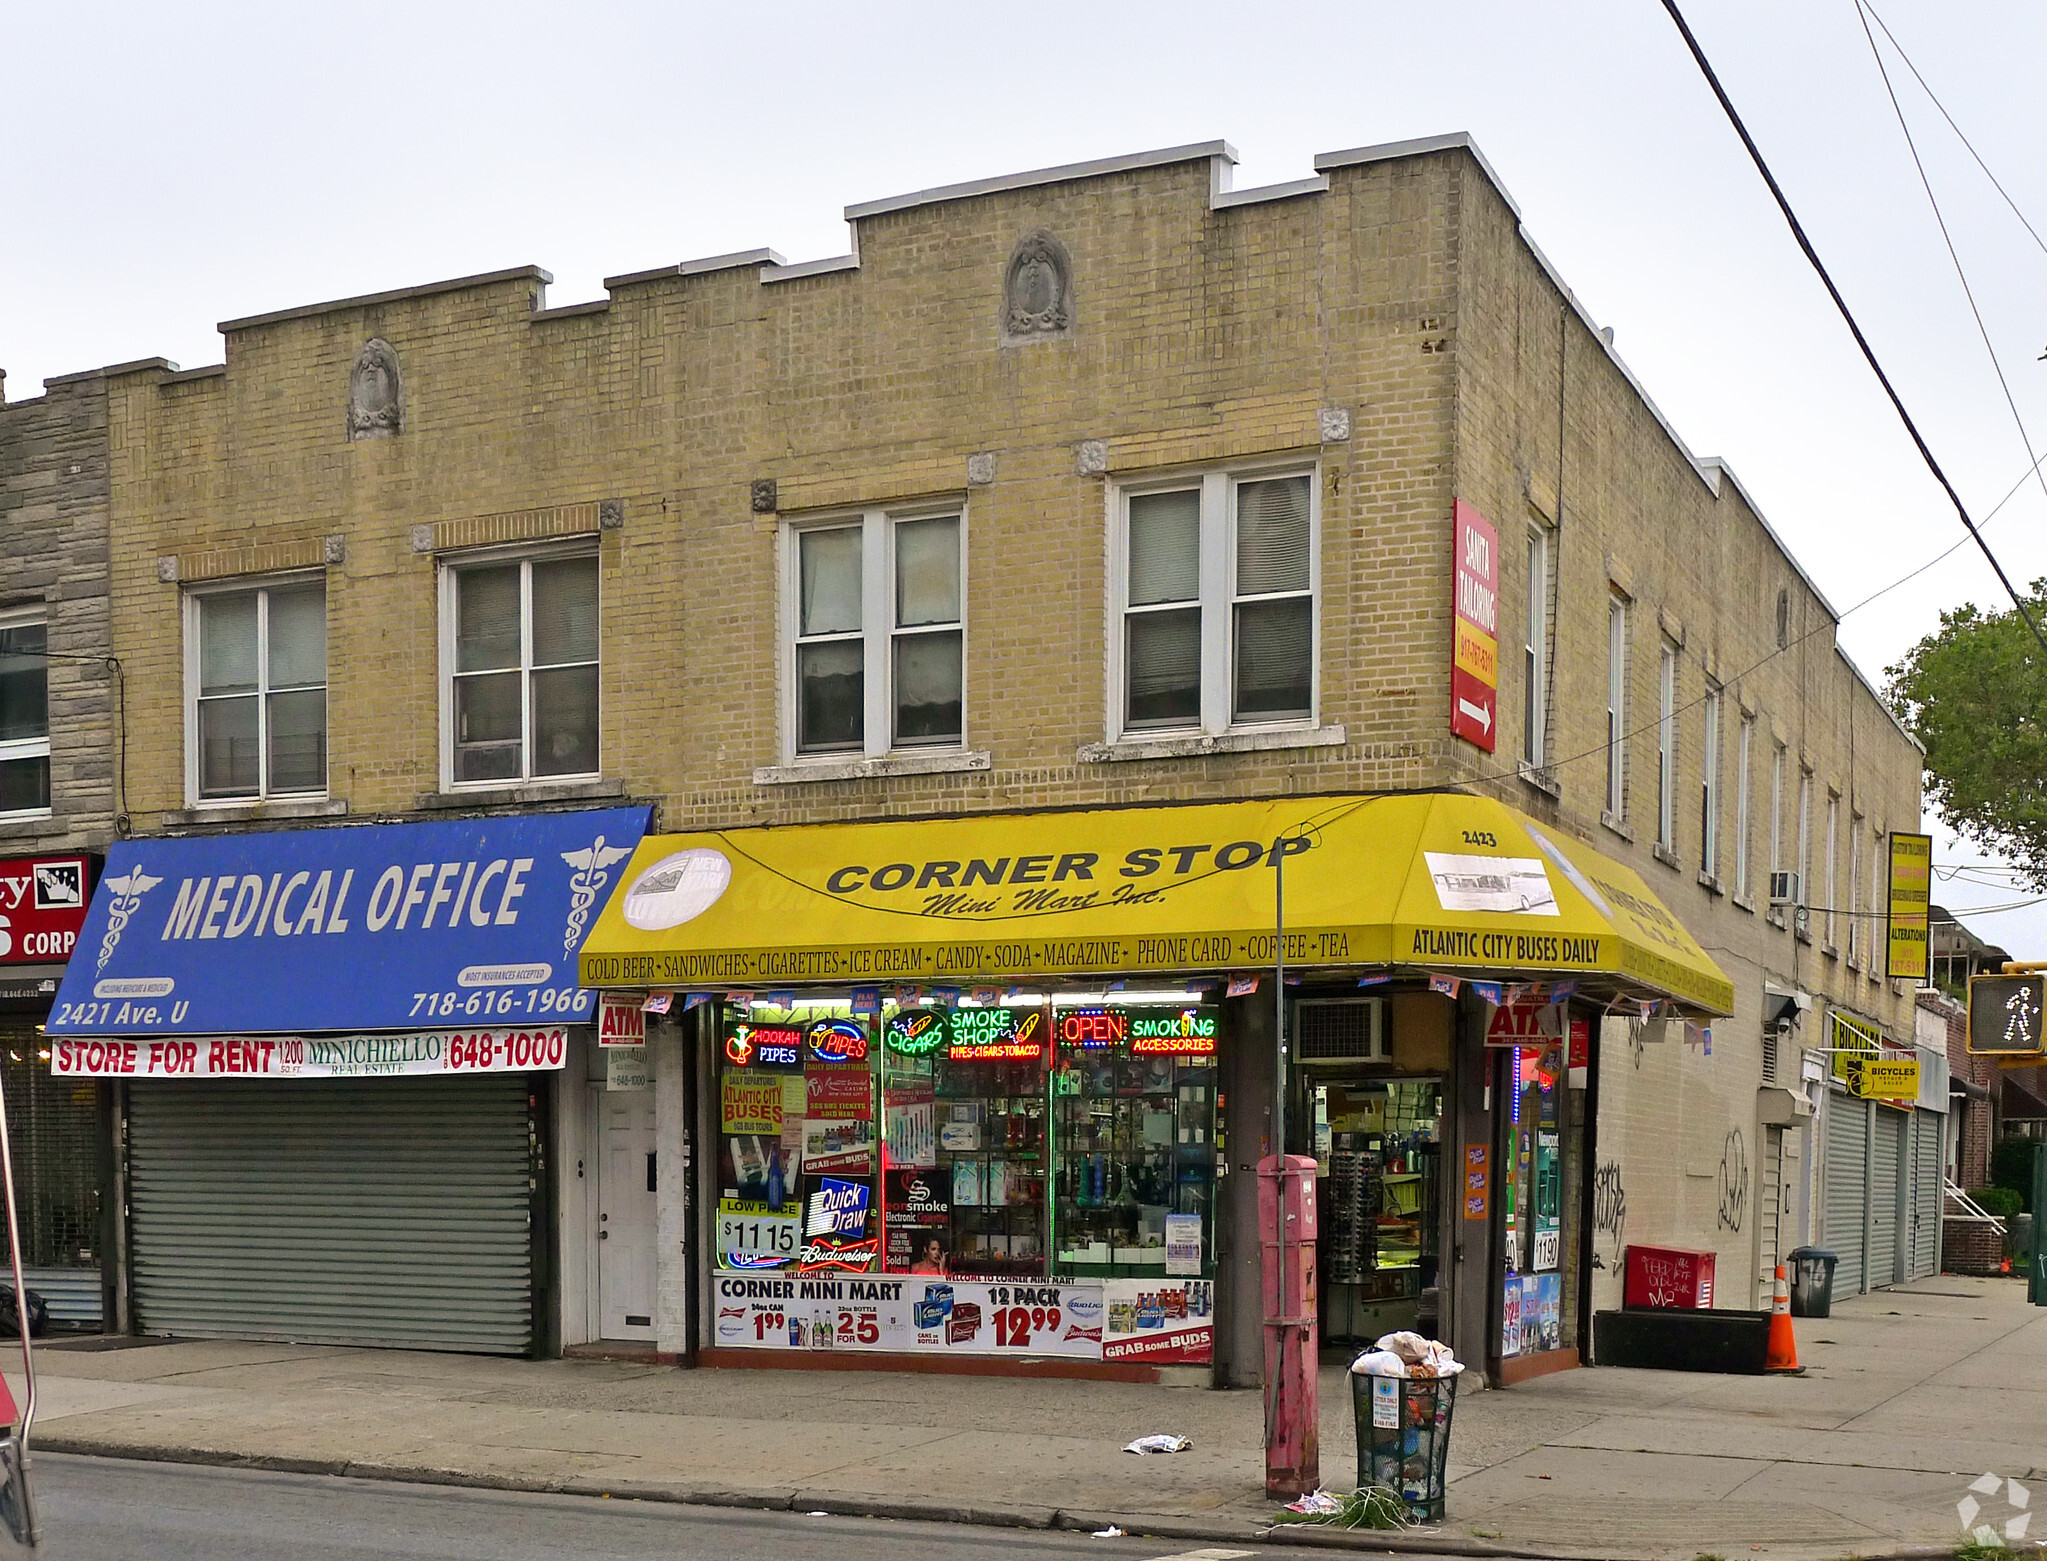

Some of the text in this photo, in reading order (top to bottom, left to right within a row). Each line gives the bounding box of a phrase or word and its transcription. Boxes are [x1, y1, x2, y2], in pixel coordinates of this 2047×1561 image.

[1462, 831, 1497, 848] 2423
[826, 837, 1313, 894] CORNER STOP
[161, 858, 534, 941] MEDICAL OFFICE
[921, 883, 1166, 916] Mini Mart Inc.
[23, 931, 76, 956] CORP
[1891, 928, 1926, 942] ALTERATIONS
[1412, 928, 1600, 964] ATLANTIC CITY BUSES DAILY
[587, 958, 620, 980] COLD
[623, 956, 655, 979] BEER
[663, 953, 749, 978] SANDWICHES
[758, 951, 839, 976] CIGARETTES
[849, 950, 871, 973] ICE
[874, 947, 922, 972] CREAM
[936, 945, 985, 970] CANDY
[994, 944, 1032, 968] SODA
[1043, 941, 1121, 967] MAGAZINE
[1137, 938, 1188, 964] PHONE
[1191, 937, 1232, 962] CARD
[1319, 933, 1350, 958] TEA
[464, 968, 545, 982] MOST INSURANCES ACCEPTED
[408, 987, 590, 1017] 718-616-1966
[855, 1000, 876, 1009] HERE!
[857, 993, 874, 1001] PLAY
[55, 1000, 190, 1025] 2421 Ave. U
[601, 1006, 644, 1036] ATM
[950, 1010, 1011, 1028] SMOKE
[753, 1028, 801, 1046] HOOKAH
[952, 1028, 998, 1046] SHOP
[1064, 1016, 1124, 1040] OPEN
[1131, 1018, 1215, 1037] SMOKING
[824, 1033, 867, 1058] PIPES
[887, 1022, 944, 1054] CIGARS
[1133, 1038, 1215, 1051] ACCESSORIES
[58, 1040, 276, 1074] STORE FOR RENT
[279, 1040, 304, 1065] 1,200
[308, 1035, 441, 1065] MINICHIELLO
[450, 1030, 563, 1069] 648-1000
[759, 1046, 797, 1064] PIPES
[331, 1062, 405, 1075] REAL ESTATE
[1871, 1067, 1916, 1076] BICYCLES
[724, 1085, 783, 1105] ATLANTIC CITY
[724, 1104, 783, 1124] BUSES
[806, 1159, 830, 1171] GRAB
[845, 1152, 869, 1164] BUDS
[727, 1201, 755, 1212] LOW
[821, 1183, 862, 1211] Quick
[829, 1209, 867, 1233] Draw
[885, 1211, 916, 1223] Electronic
[800, 1245, 877, 1263] Budweiser
[885, 1255, 902, 1265] Sold
[784, 1271, 834, 1280] WELCOME TO
[945, 1275, 1076, 1285] WELCOME TO CORNER MINI MART
[721, 1279, 903, 1301] CORNER MINI MART
[988, 1286, 1061, 1307] 12 PACK
[769, 1304, 784, 1312] CAN
[837, 1313, 854, 1335] 2
[837, 1335, 856, 1344] FOR
[1105, 1331, 1211, 1357] GRAB SOME BUDS
